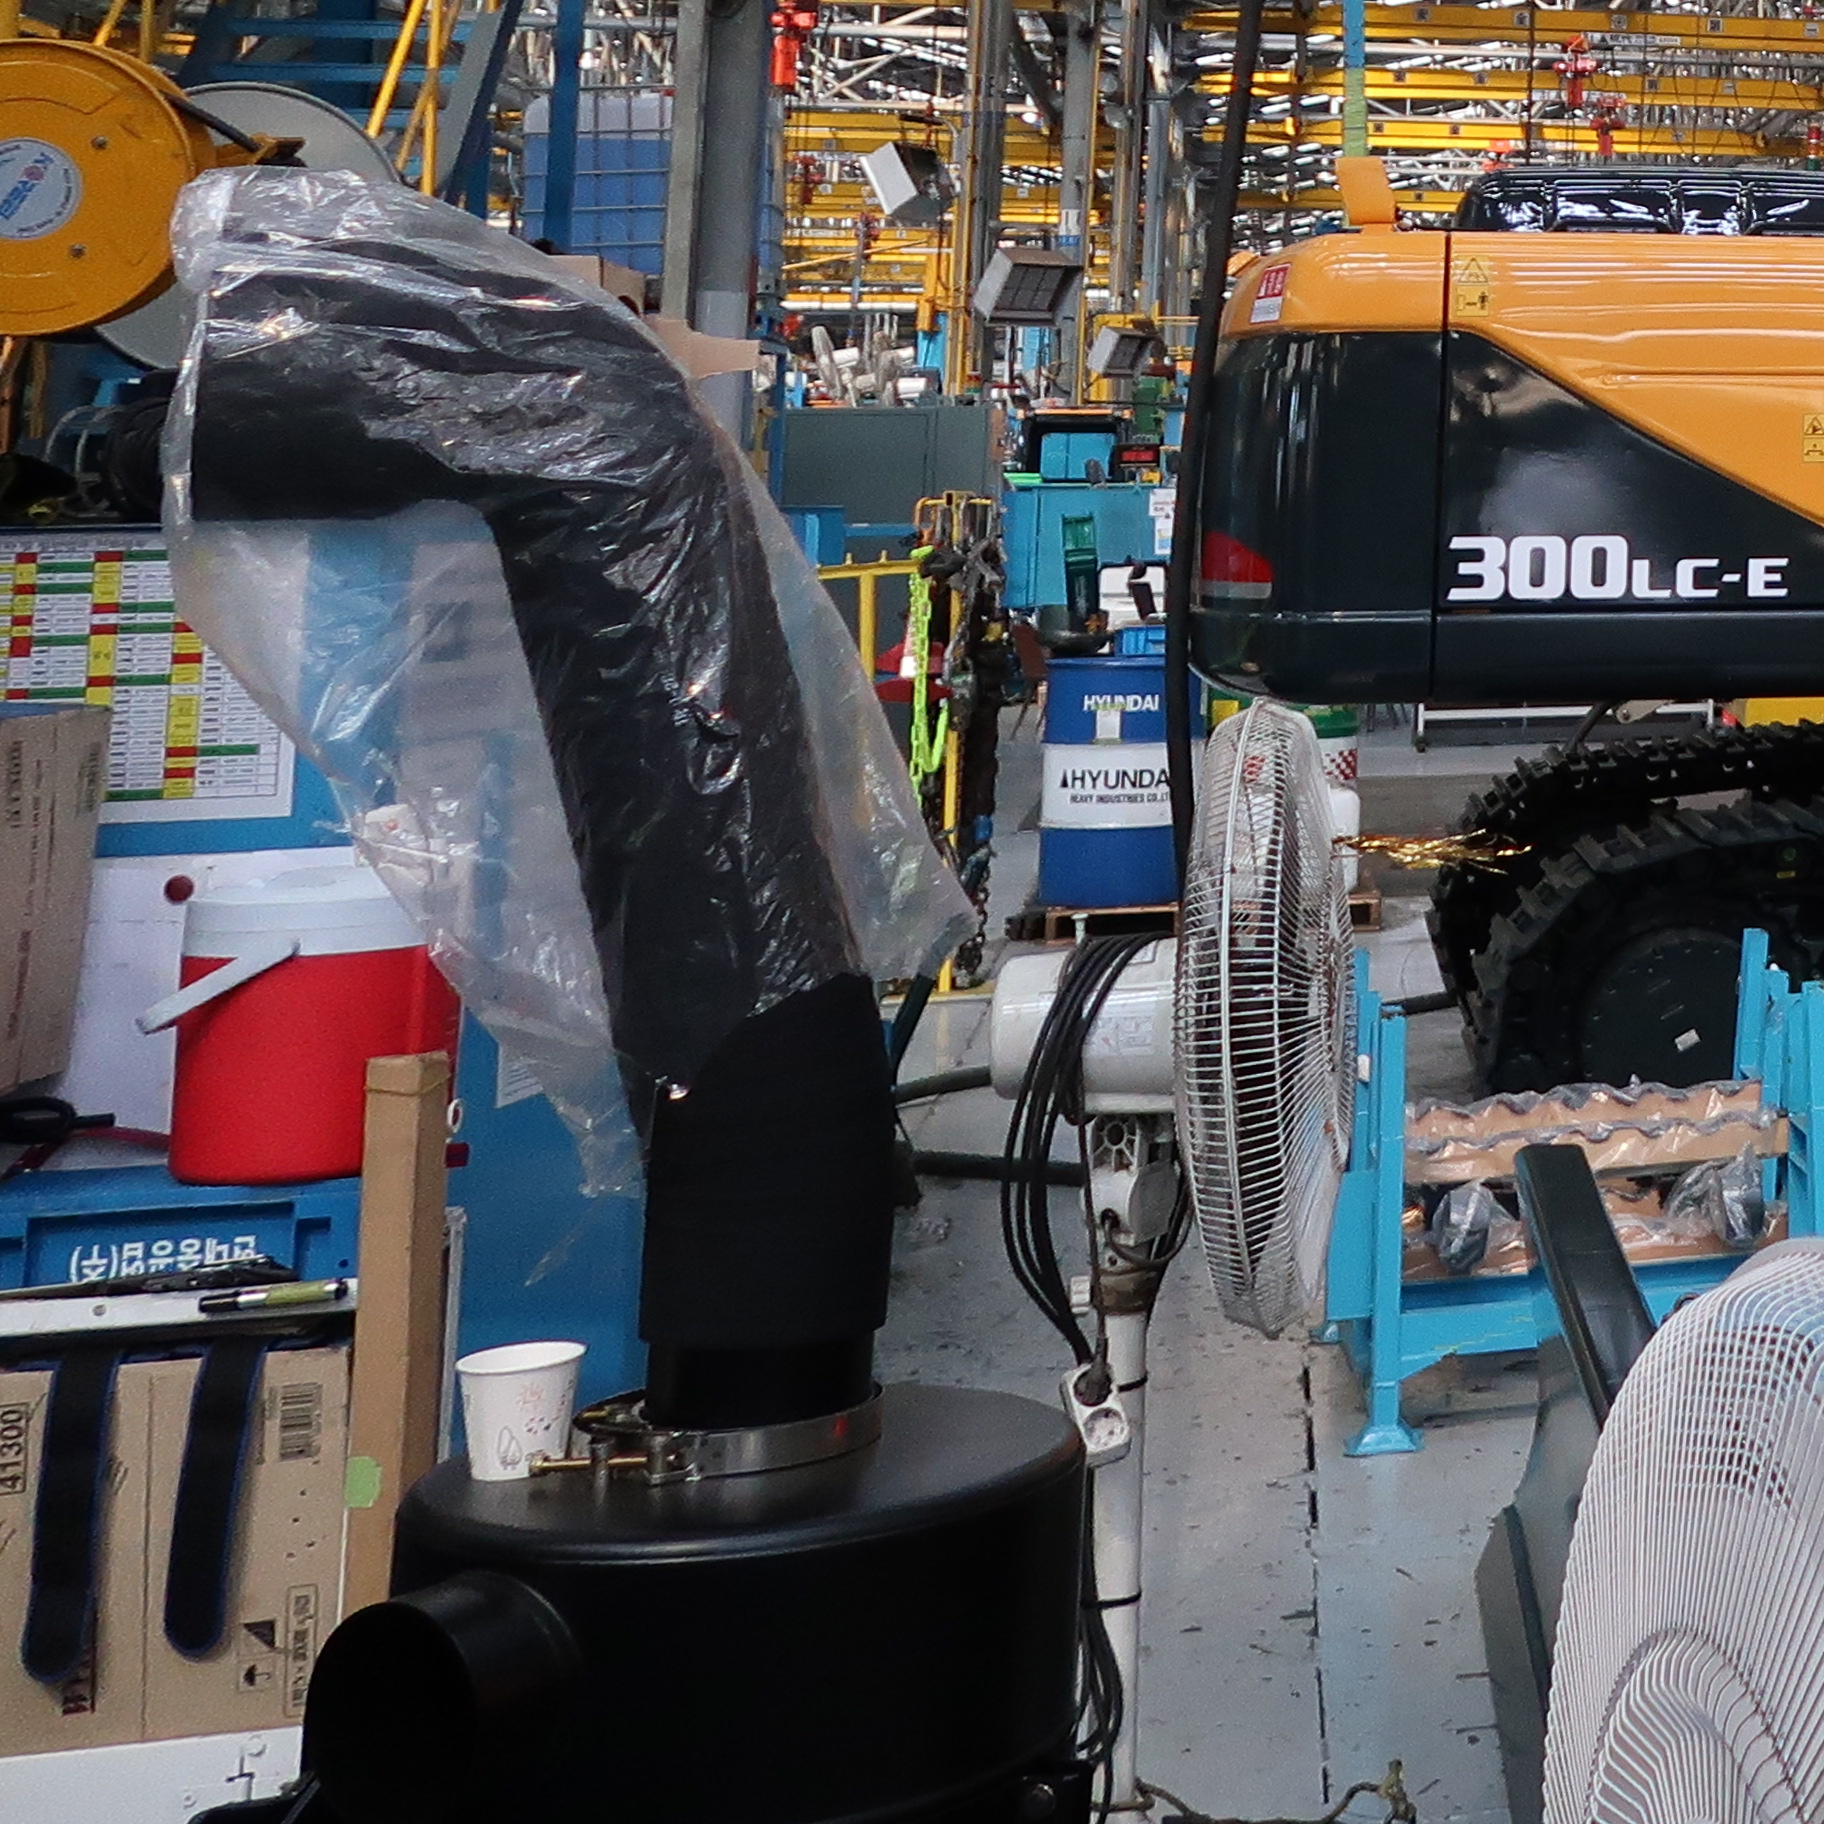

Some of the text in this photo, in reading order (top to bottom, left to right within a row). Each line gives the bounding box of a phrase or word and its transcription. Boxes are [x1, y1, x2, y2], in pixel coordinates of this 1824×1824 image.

[1083, 693, 1160, 712] HYUNDAI
[1070, 768, 1171, 790] HYUNDA
[1070, 792, 1093, 804] HEAVY
[1096, 792, 1145, 804] INDUSTRIES
